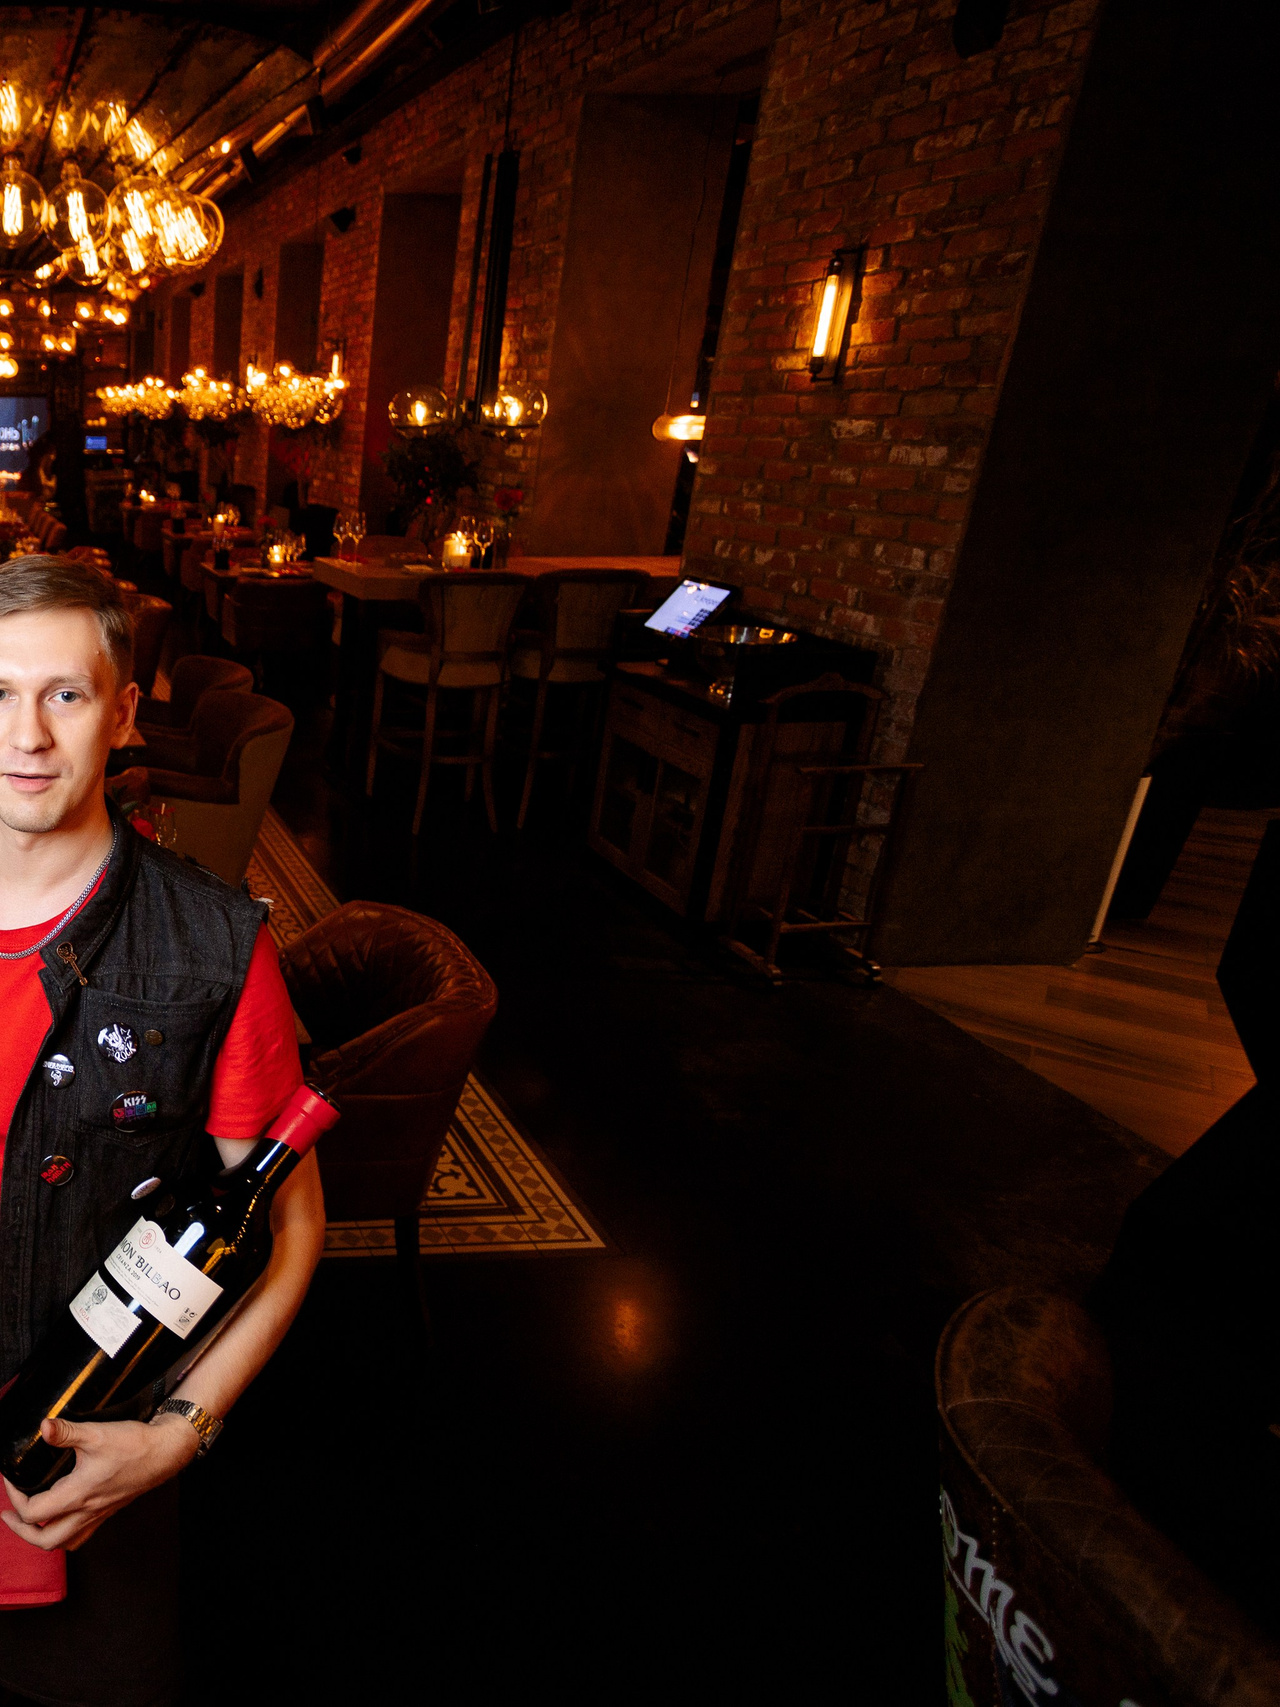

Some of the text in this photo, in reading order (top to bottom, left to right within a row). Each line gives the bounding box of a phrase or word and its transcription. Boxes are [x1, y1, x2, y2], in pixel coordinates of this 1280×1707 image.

[114, 1041, 137, 1064] ROCK
[123, 1095, 147, 1107] KISS
[115, 1253, 132, 1273] CRIANZA
[135, 1255, 181, 1301] BILBAO
